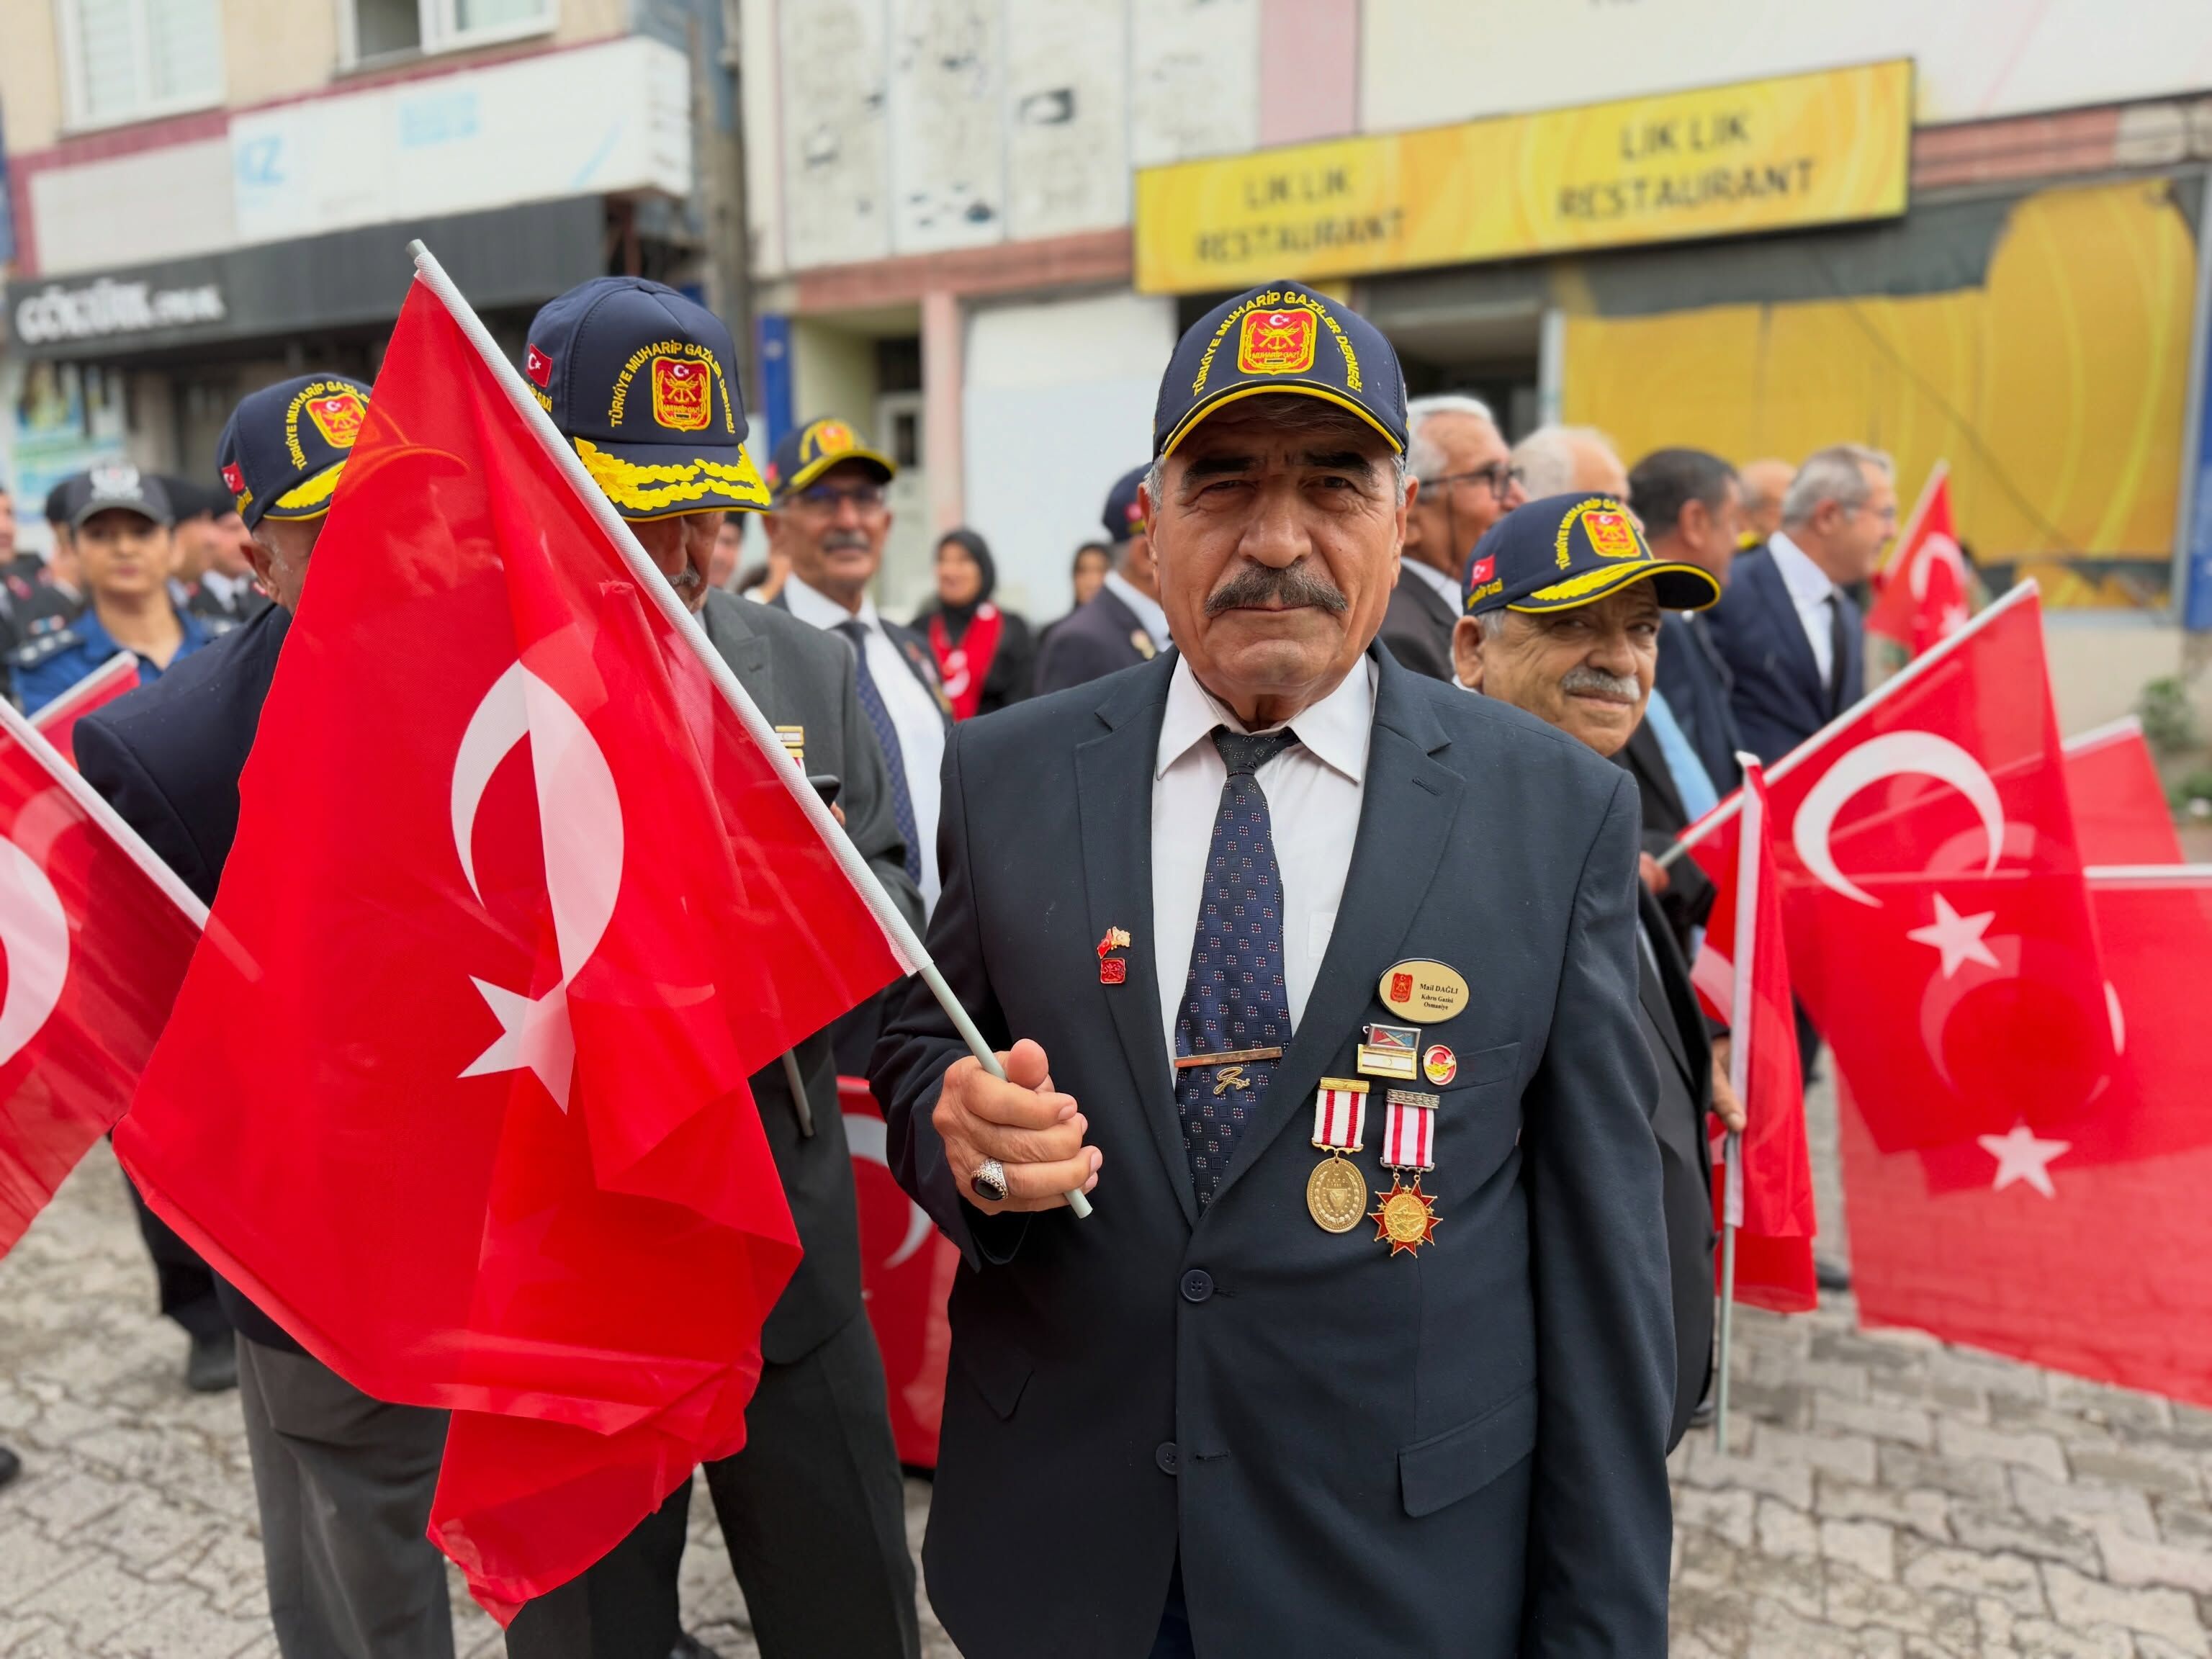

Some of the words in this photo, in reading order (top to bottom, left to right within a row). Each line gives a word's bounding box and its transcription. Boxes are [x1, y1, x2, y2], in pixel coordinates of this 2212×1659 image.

[1558, 156, 1815, 220] RESTAURANT
[1196, 207, 1406, 262] RESTAURANT
[1192, 338, 1221, 396] TÜRKİYE
[1215, 290, 1281, 336] MUHARİP
[1284, 291, 1341, 334] GAZİLER
[1336, 336, 1362, 393] DERNEĞİ
[286, 382, 325, 424] MUHARİP
[608, 369, 634, 428] TÜRKİYE
[626, 340, 683, 374] MUHARİP
[286, 424, 307, 471] TÜRKİYE
[1424, 1002, 1449, 1010] Osmaniye
[1435, 985, 1458, 994] DAĞLI
